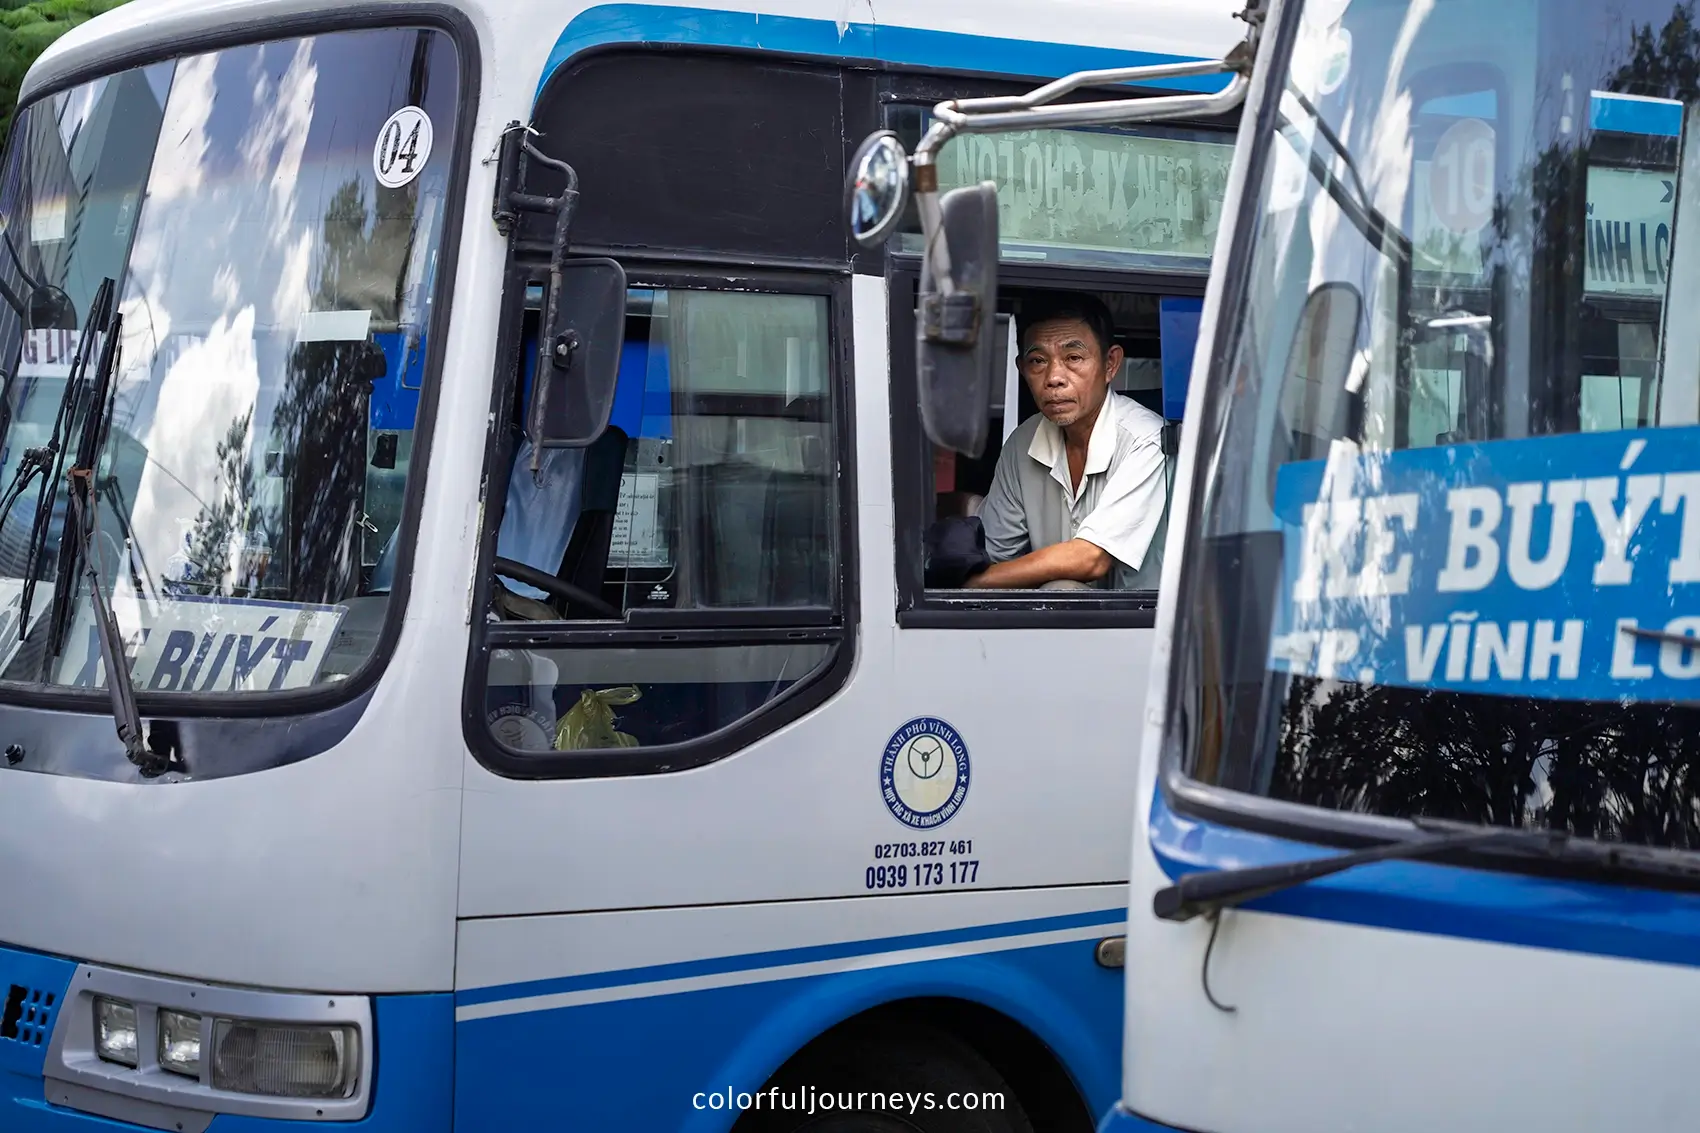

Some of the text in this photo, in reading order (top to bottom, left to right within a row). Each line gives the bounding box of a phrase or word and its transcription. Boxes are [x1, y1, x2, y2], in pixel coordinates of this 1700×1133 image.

[380, 119, 421, 175] 04
[1292, 493, 1420, 602] XE
[147, 615, 313, 692] BUÝT
[1404, 611, 1585, 682] VĨNH
[883, 733, 906, 774] THÀNH
[905, 718, 927, 738] PHỐ
[951, 738, 967, 771] LONG
[911, 815, 920, 826] XE
[920, 813, 943, 827] KHÁCH
[952, 785, 967, 806] LONG
[865, 860, 980, 889] 0939 173 177
[875, 839, 972, 859] 02703.827 461
